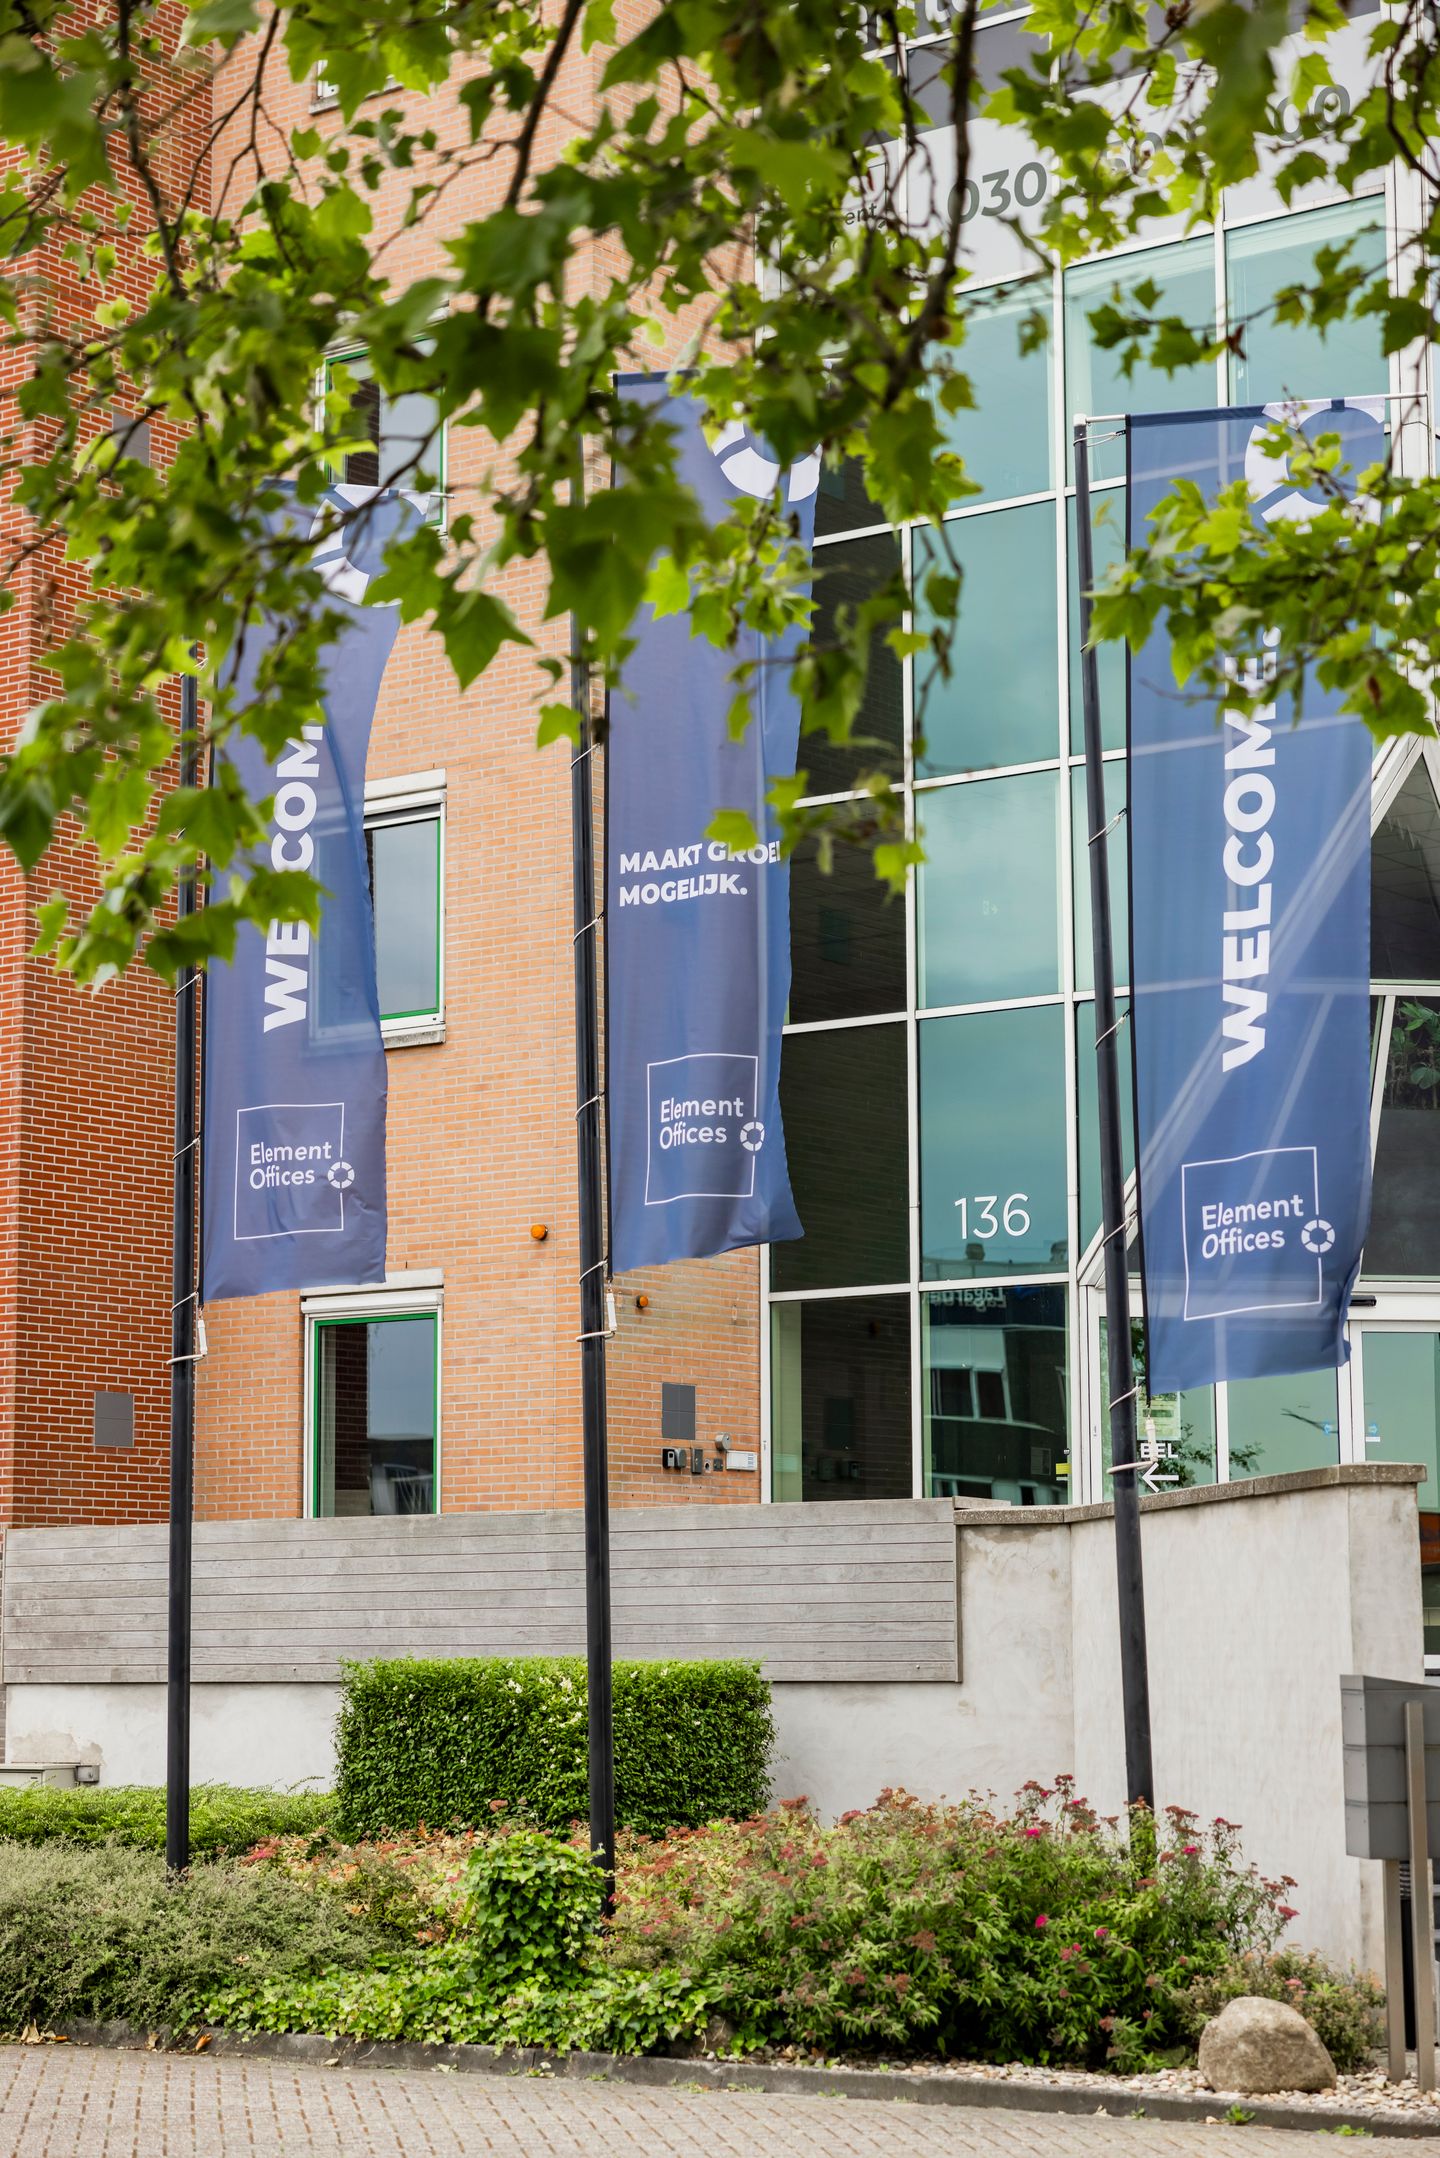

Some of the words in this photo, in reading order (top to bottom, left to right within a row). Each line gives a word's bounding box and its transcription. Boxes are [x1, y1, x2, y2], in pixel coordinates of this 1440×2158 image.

[947, 162, 1047, 224] 030
[620, 843, 703, 875] MAAKT
[619, 873, 748, 907] MOGELIJK.
[660, 1097, 744, 1123] Element
[659, 1121, 728, 1150] Offices
[250, 1141, 332, 1165] Element
[249, 1164, 315, 1190] Offices
[954, 1193, 1031, 1240] 136
[1202, 1194, 1304, 1230] Element
[1202, 1227, 1286, 1259] Offices
